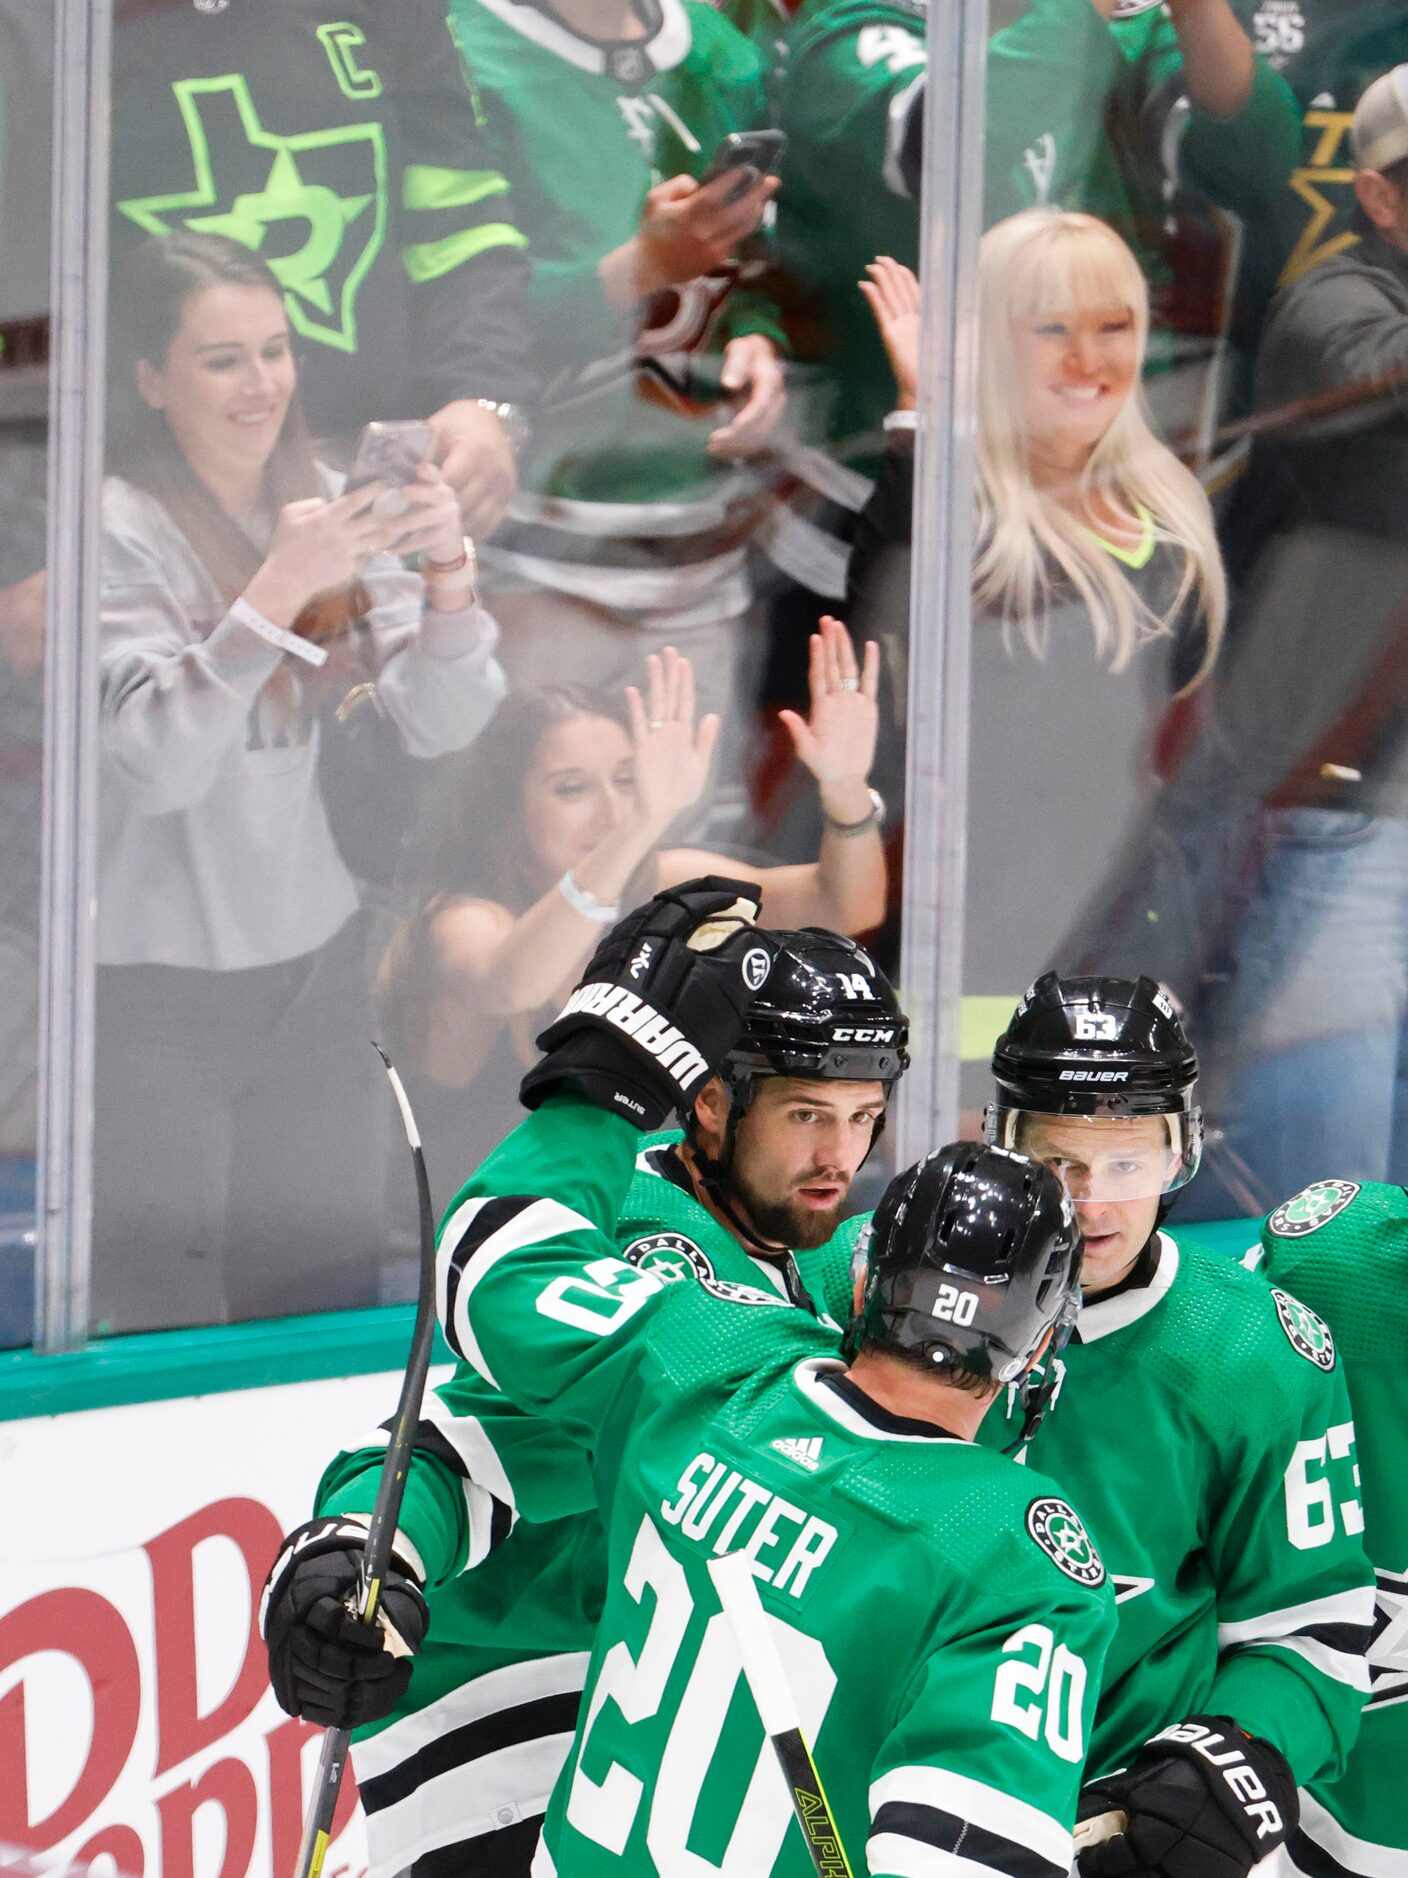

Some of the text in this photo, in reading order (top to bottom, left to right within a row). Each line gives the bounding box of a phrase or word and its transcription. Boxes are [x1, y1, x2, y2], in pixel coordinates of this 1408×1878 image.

[316, 22, 382, 100] C
[835, 973, 876, 1001] 14
[553, 982, 709, 1091] WARR
[832, 1028, 894, 1043] CCM
[1074, 1014, 1116, 1041] 63
[931, 1283, 979, 1327] 20
[661, 1452, 839, 1598] SUTER
[566, 1513, 839, 1878] 20
[990, 1623, 1088, 1764] 20
